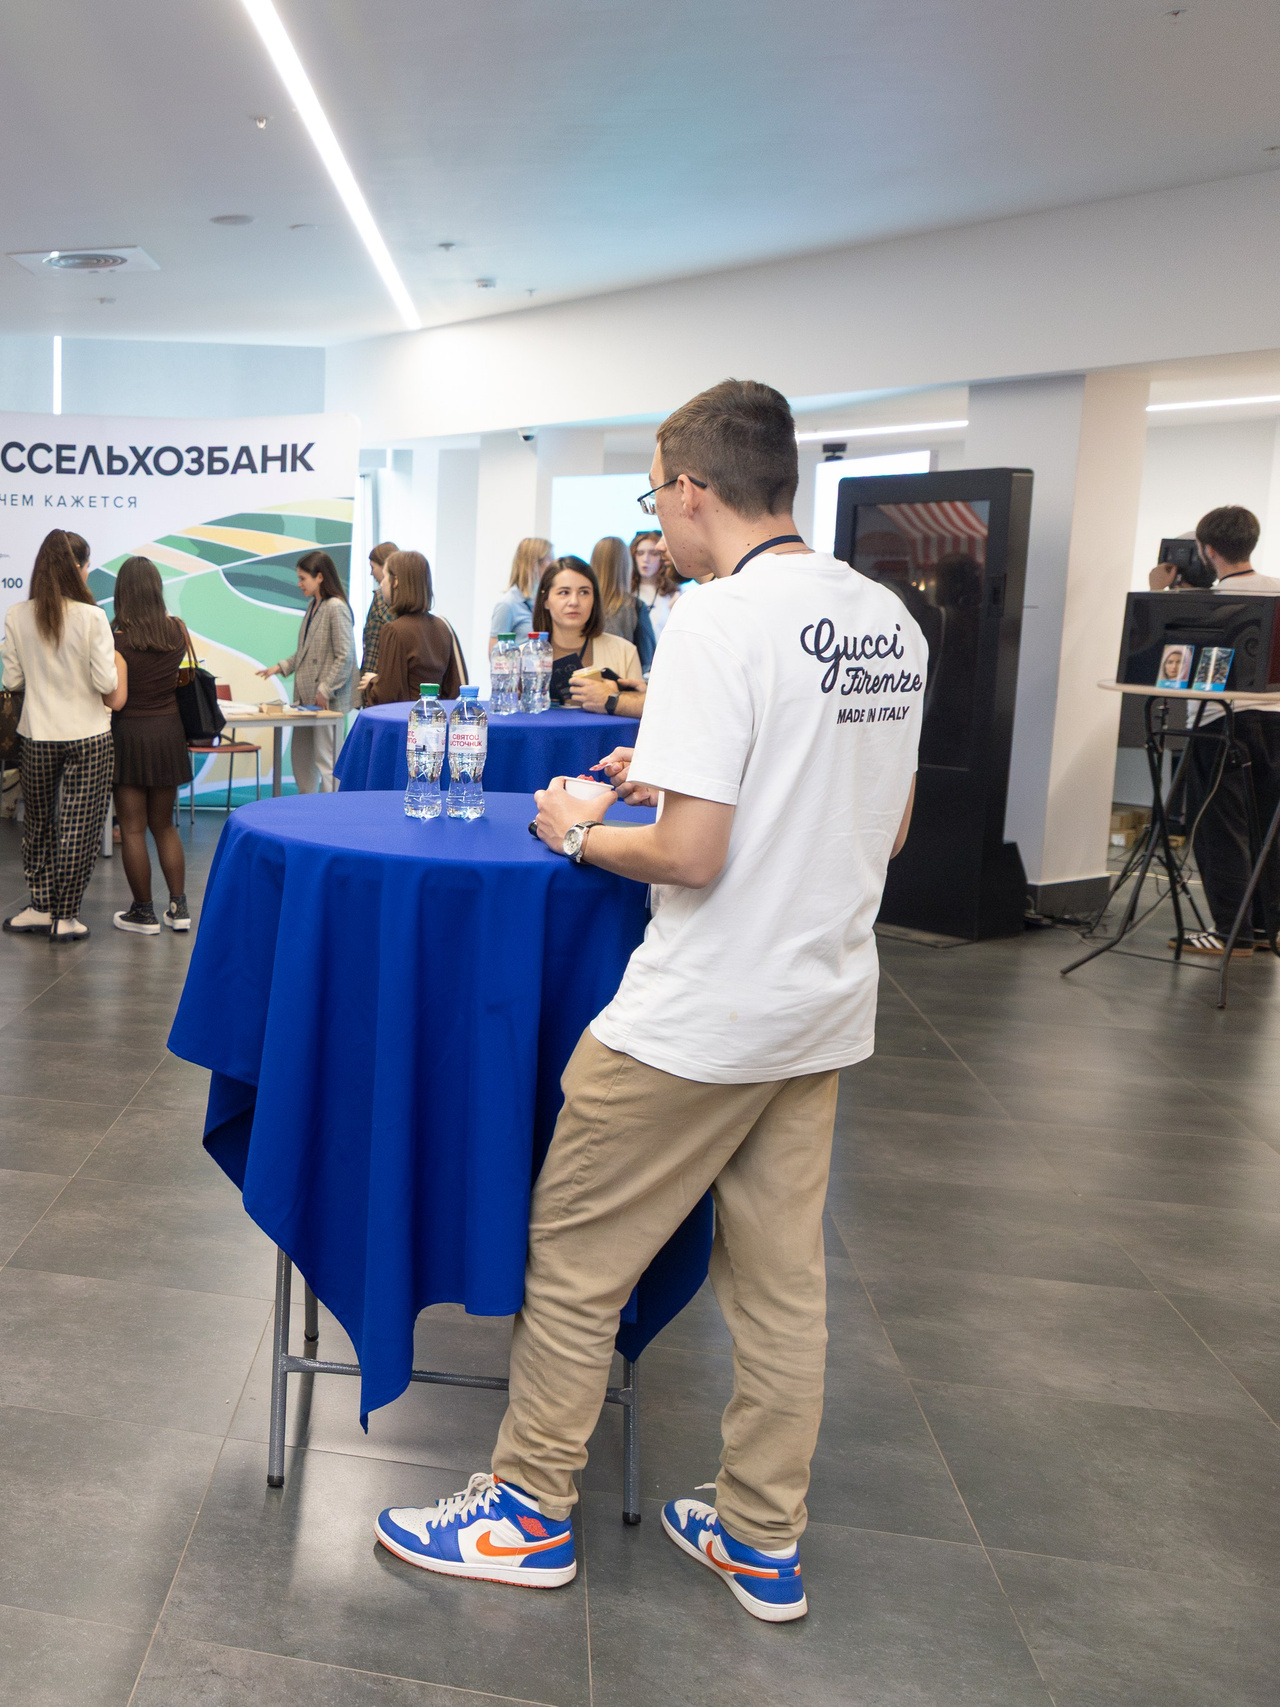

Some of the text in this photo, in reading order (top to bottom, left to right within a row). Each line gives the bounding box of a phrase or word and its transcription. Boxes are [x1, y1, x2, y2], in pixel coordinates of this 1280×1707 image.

[44, 495, 138, 509] КАЖЕТСЯ
[1, 577, 23, 589] 100
[800, 617, 904, 694] Gucci
[840, 666, 923, 696] Firenze
[836, 705, 910, 724] MADE IN ITALY
